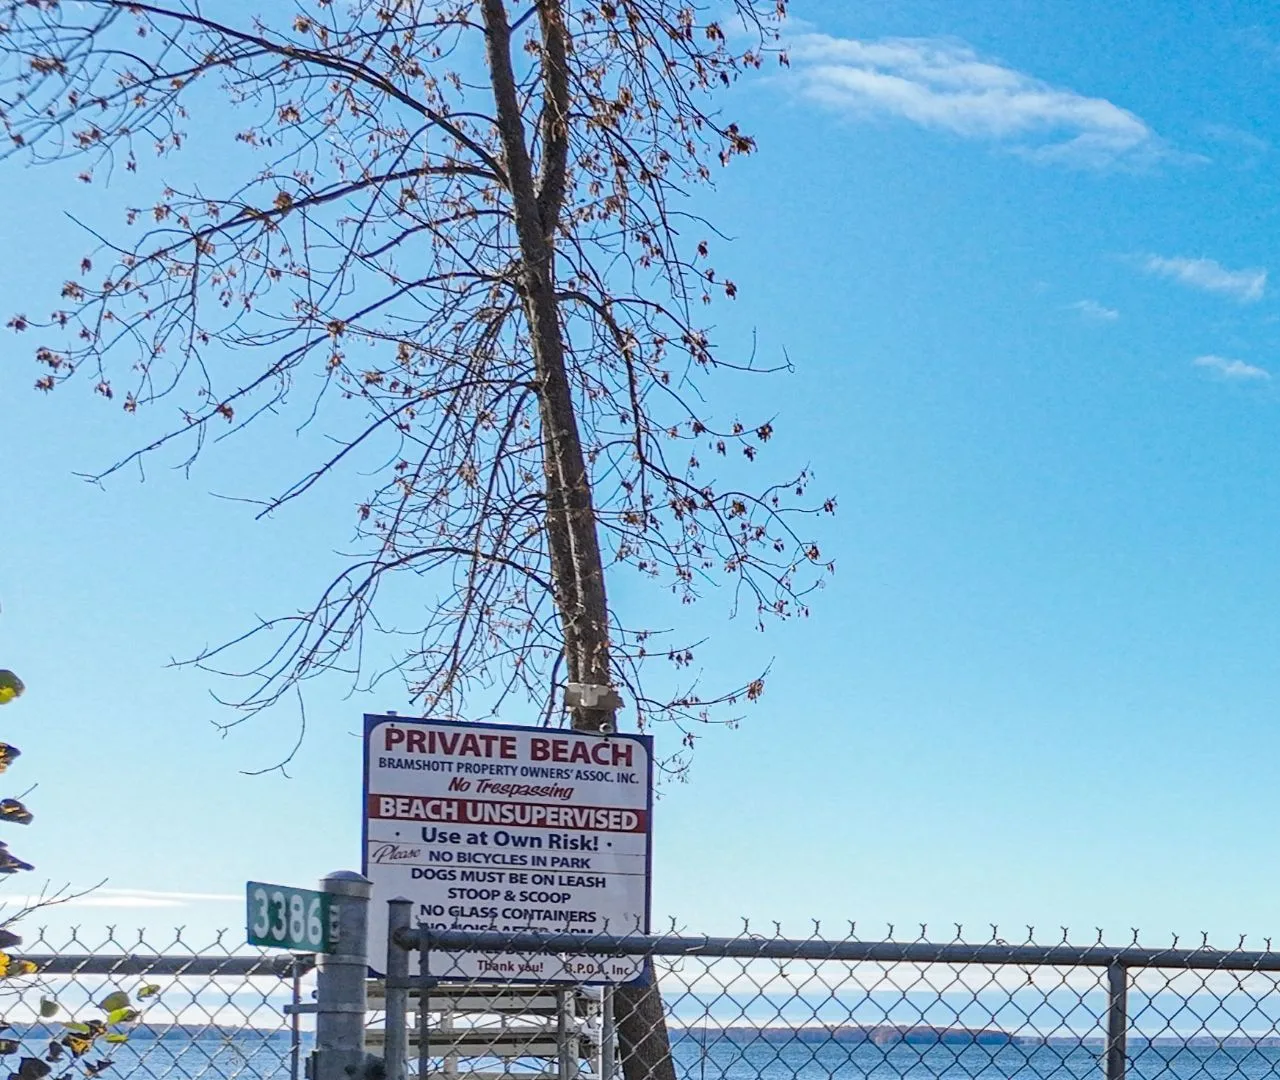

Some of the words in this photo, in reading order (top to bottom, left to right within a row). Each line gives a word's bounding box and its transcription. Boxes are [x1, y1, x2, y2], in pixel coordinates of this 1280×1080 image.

[385, 727, 517, 759] PRIVATE
[530, 738, 633, 767] BEACH
[378, 757, 454, 773] BRAMSHOTT
[456, 762, 518, 776] PROPERTY
[575, 769, 614, 783] ASSOC.
[616, 772, 639, 784] INC.
[447, 777, 471, 793] No
[475, 779, 574, 801] Trespassing
[379, 797, 458, 821] BEACH
[466, 801, 639, 831] UNSUPERVISED
[421, 827, 461, 844] Use
[466, 831, 489, 846] at
[493, 831, 543, 849] Own
[548, 834, 599, 851] Risk!
[372, 844, 421, 863] Please
[428, 851, 453, 862] NO
[457, 852, 528, 866] BICYCLES
[531, 855, 547, 867] IN
[551, 857, 591, 869] PARK
[411, 868, 457, 881] DOGS
[460, 870, 506, 883] MUST
[508, 873, 528, 884] BE
[531, 874, 555, 886] ON
[558, 876, 606, 888] LEASH
[447, 888, 501, 900] STOOP
[504, 890, 516, 902] &
[519, 891, 571, 904] SCOOP
[253, 888, 322, 945] 3386
[420, 904, 445, 917] NO
[448, 906, 499, 919] GLASS
[501, 908, 597, 923] CONTAINERS
[477, 960, 515, 972] Thank
[518, 961, 544, 973] you!
